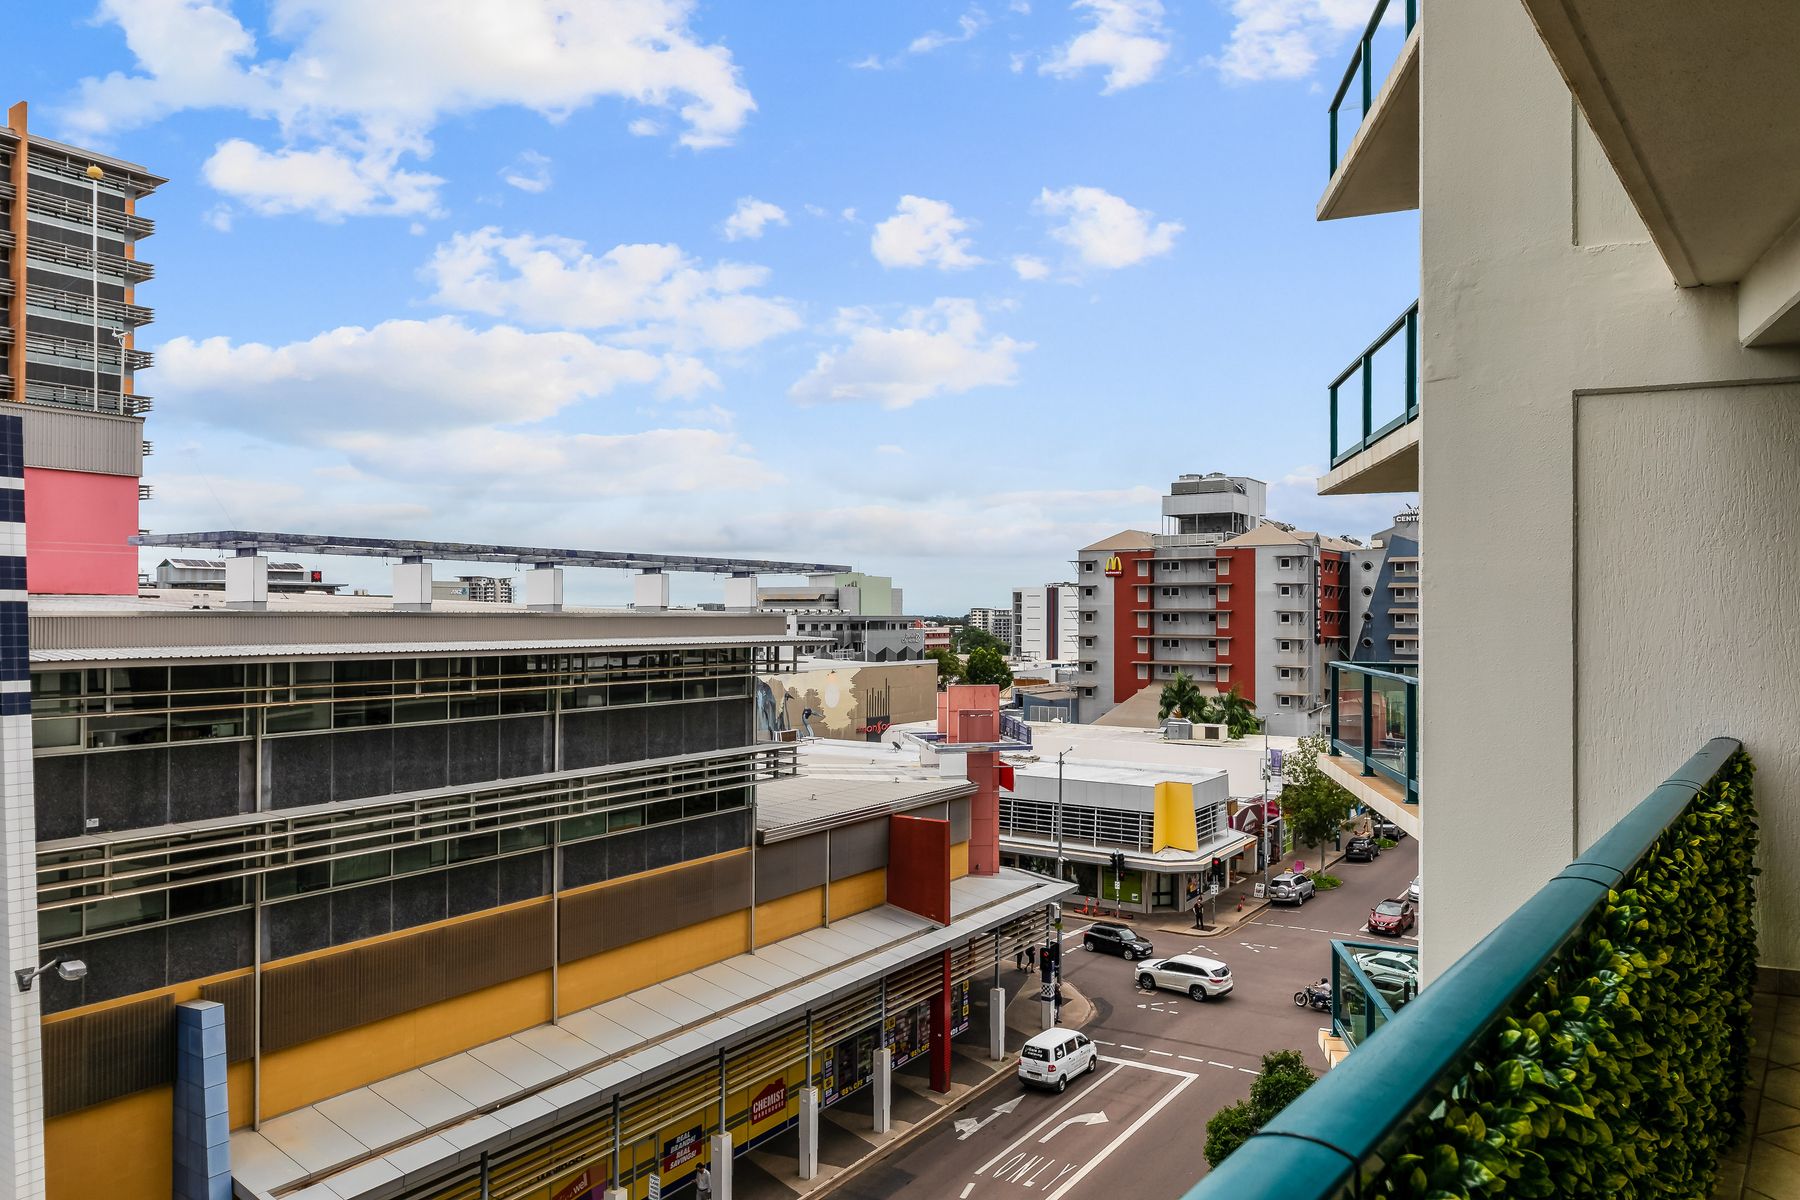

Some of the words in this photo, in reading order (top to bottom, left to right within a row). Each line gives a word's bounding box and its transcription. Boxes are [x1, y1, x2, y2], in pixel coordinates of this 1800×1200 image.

[753, 1088, 785, 1114] CHEMIST
[753, 1100, 784, 1121] WAREHOUSE
[675, 1131, 690, 1144] REAL
[670, 1149, 697, 1170] SAVINGS!
[675, 1146, 690, 1159] REAL
[992, 1152, 1078, 1191] ONLY
